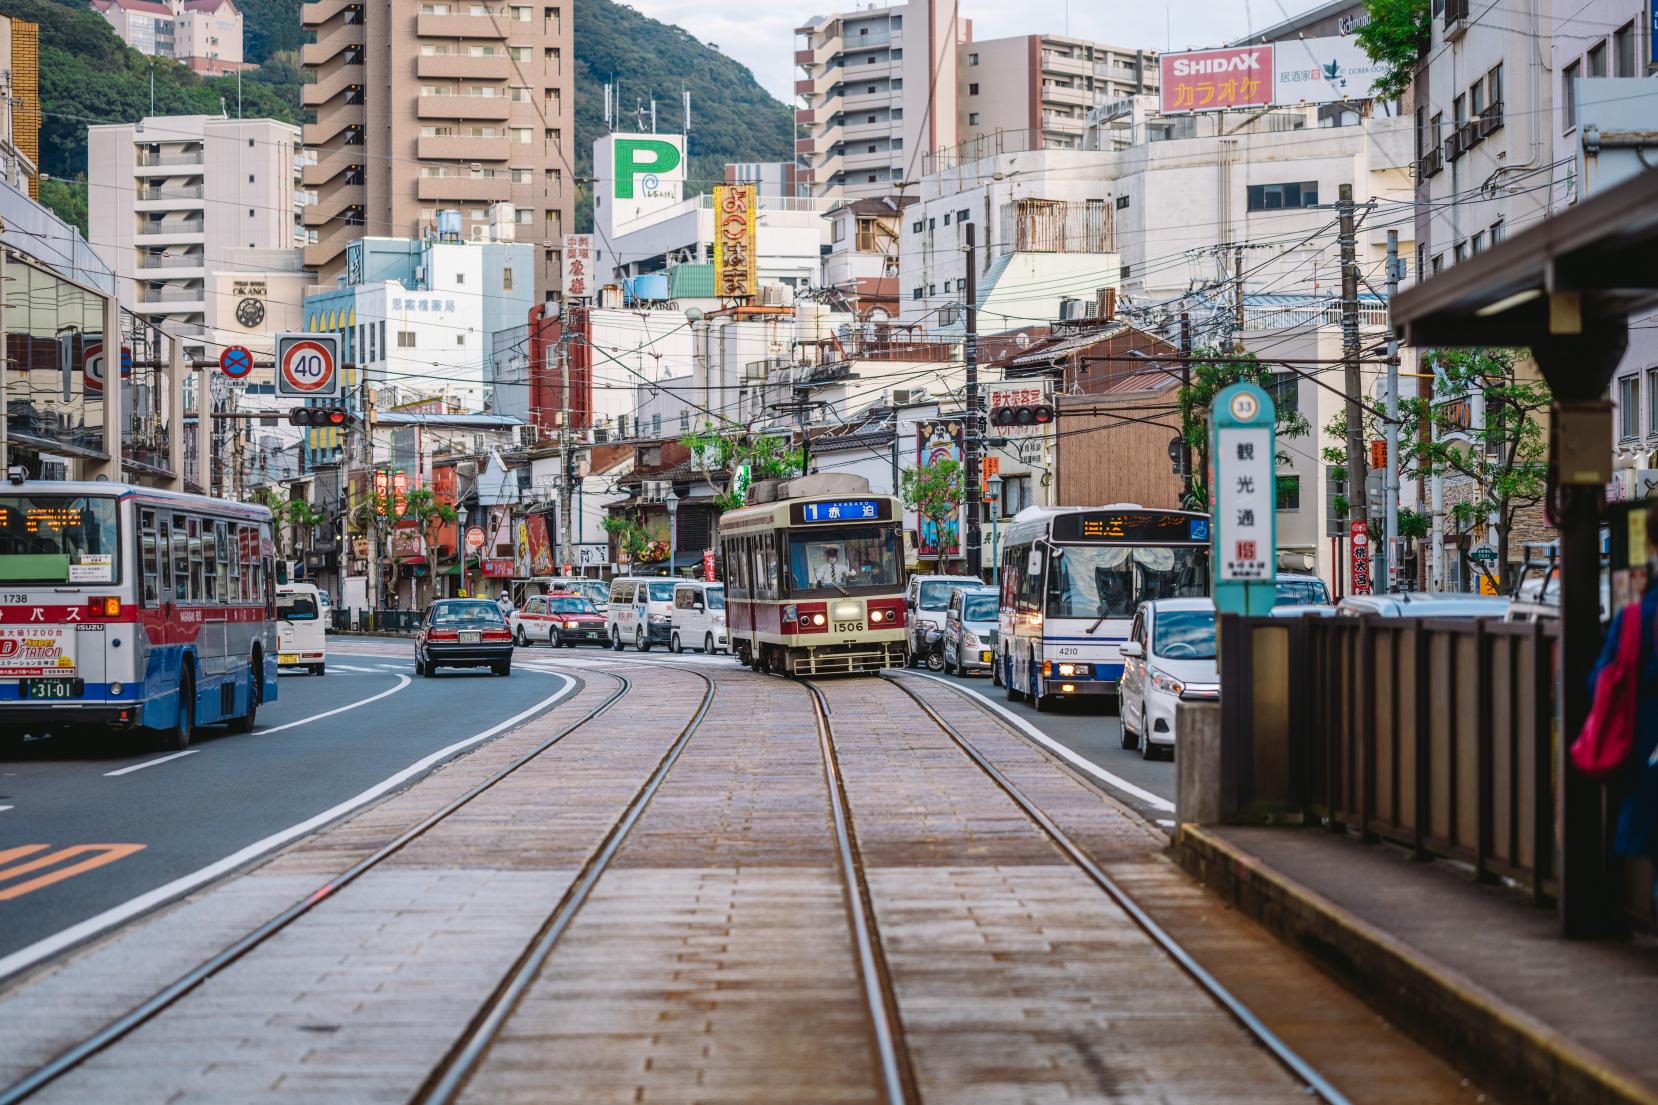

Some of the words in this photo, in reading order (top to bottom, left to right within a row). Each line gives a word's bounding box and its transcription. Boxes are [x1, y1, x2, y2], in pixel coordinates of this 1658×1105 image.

[1173, 52, 1261, 76] SHIDAX
[1173, 77, 1261, 107] カラオケ
[614, 139, 681, 199] P
[722, 187, 748, 295] よこはま
[233, 287, 267, 296] OKANO
[294, 355, 321, 377] 40
[1236, 442, 1255, 527] 観光通
[808, 504, 818, 519] 1
[828, 505, 875, 518] 赤迫
[3, 594, 28, 603] 1738
[0, 607, 81, 621] バス
[833, 622, 864, 633] 1506
[1059, 647, 1078, 655] 4210
